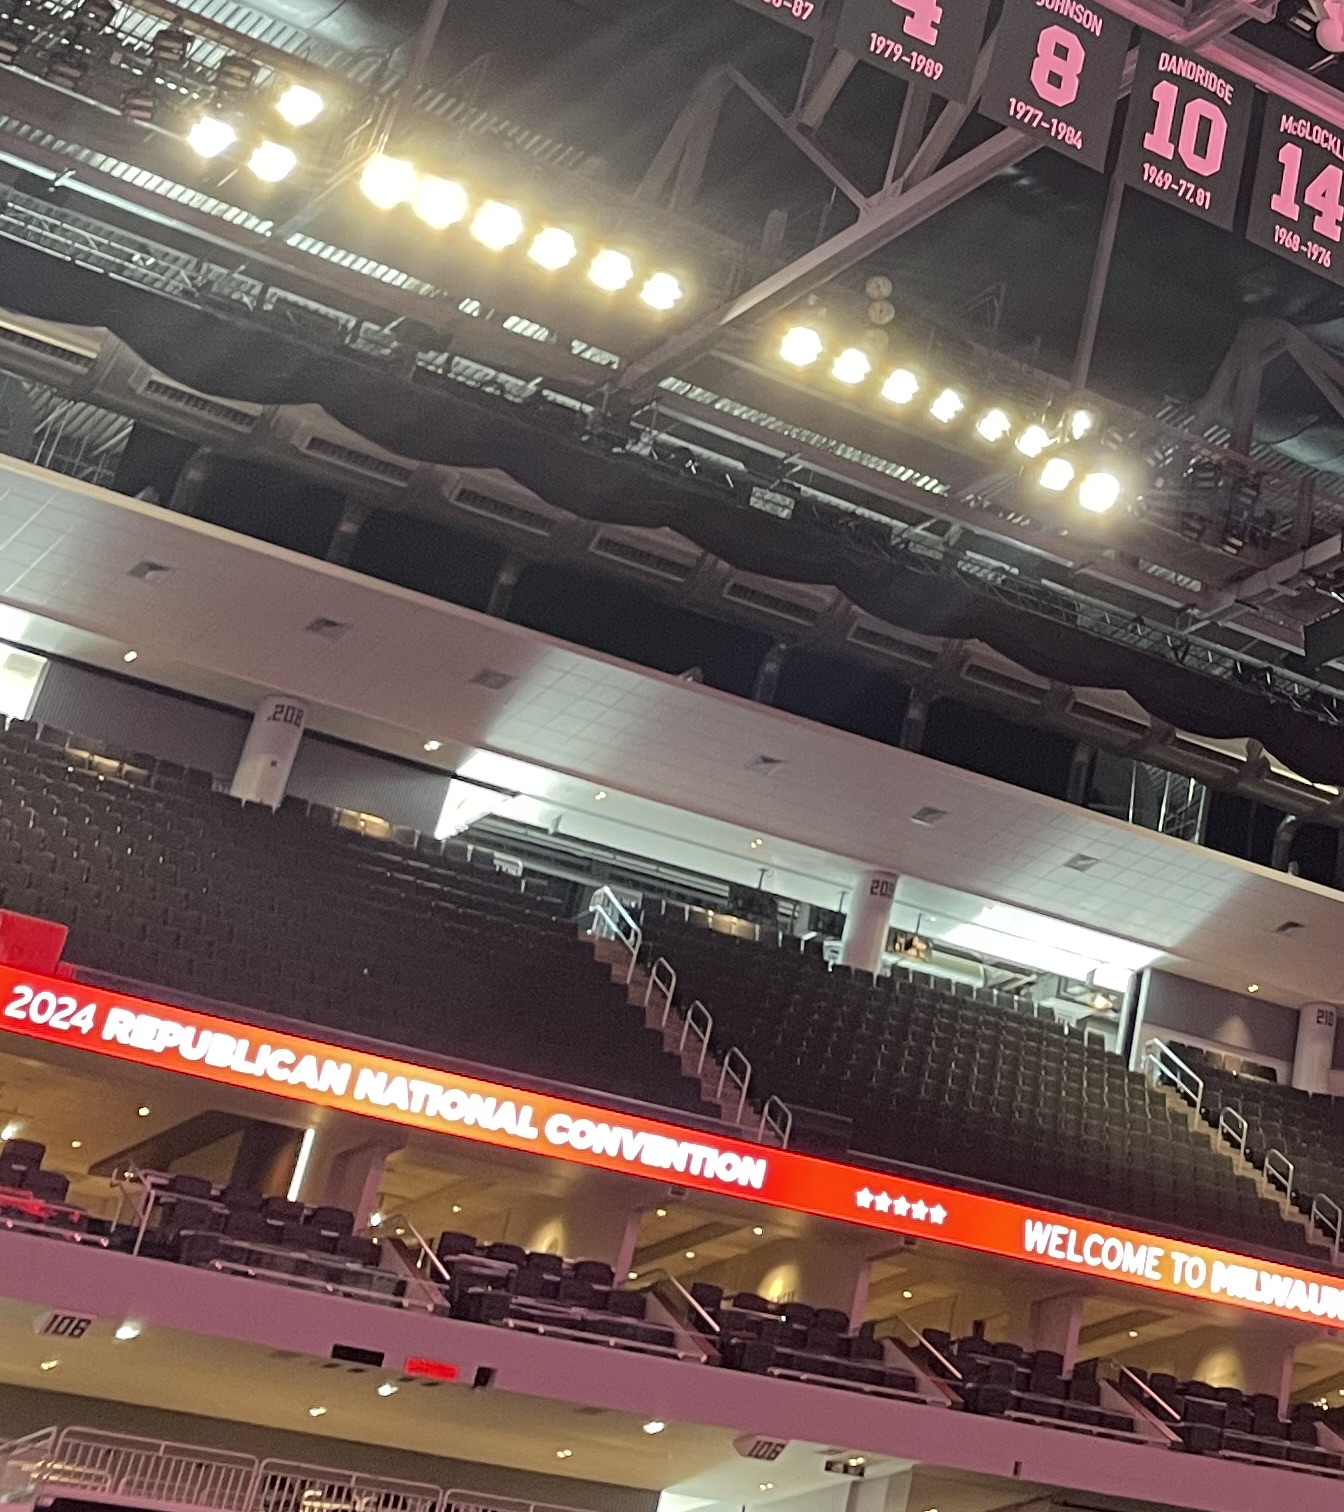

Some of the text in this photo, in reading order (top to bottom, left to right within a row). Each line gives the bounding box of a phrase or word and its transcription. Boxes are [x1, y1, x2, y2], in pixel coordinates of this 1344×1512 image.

[869, 33, 944, 81] 1979-1989
[1029, 25, 1085, 108] 8
[1158, 52, 1235, 105] DANDRIDGE
[1008, 98, 1083, 150] 1977-1984
[1143, 80, 1228, 177] 10
[1273, 223, 1333, 268] 1968-1976
[4, 986, 767, 1189] 2024 REPUBLICAN NATIONAL CONVENTION
[1024, 1219, 1165, 1281] WELCOME
[1170, 1251, 1206, 1288] TO
[44, 1314, 92, 1338] 106
